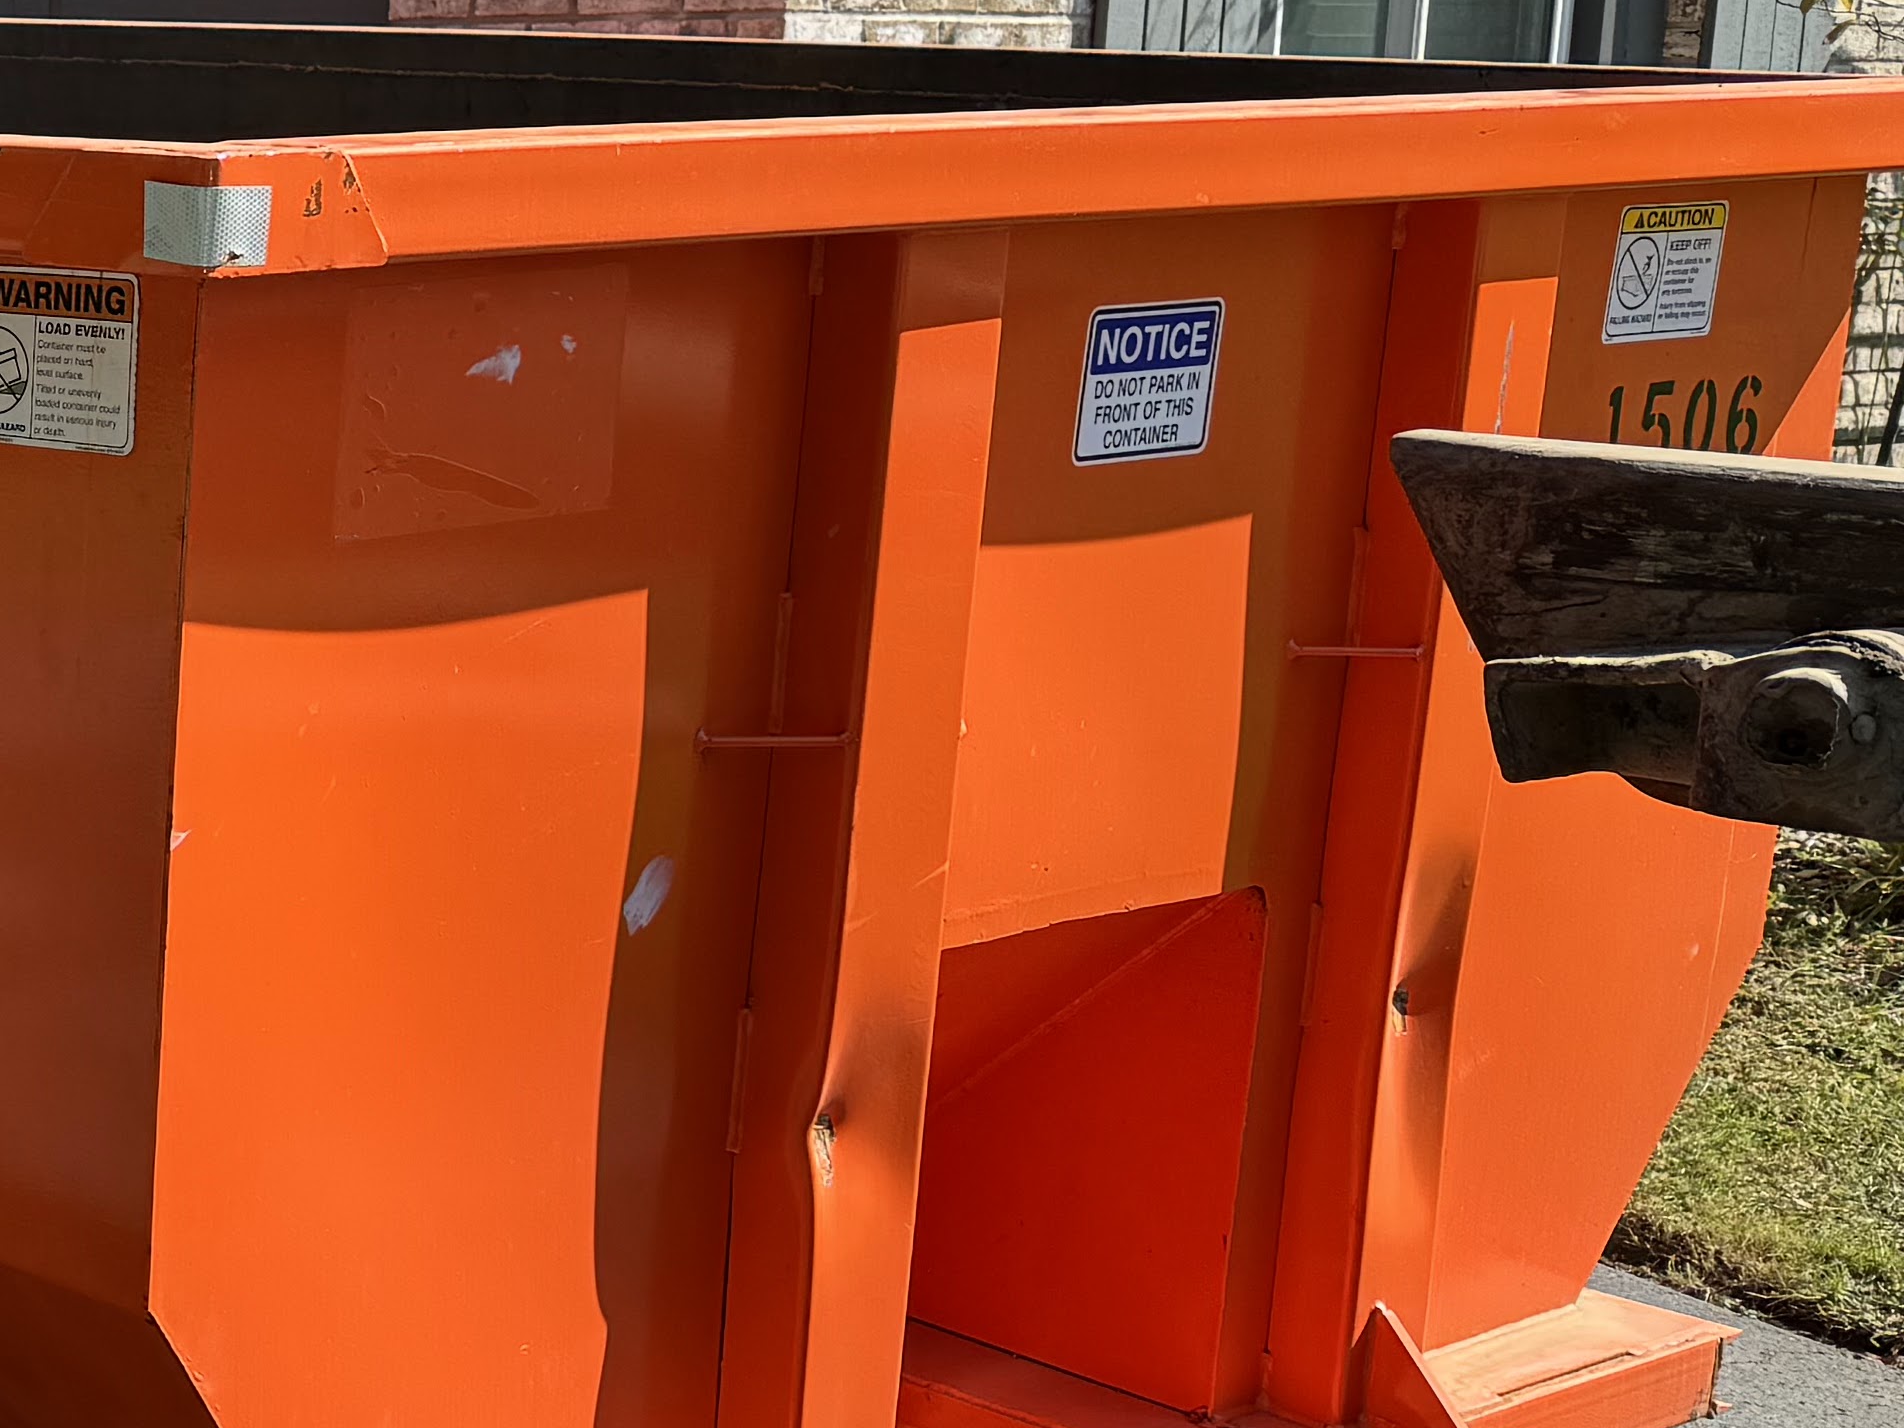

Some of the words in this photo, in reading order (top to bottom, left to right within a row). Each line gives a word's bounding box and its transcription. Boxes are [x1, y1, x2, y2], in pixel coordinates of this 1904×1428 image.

[1647, 208, 1714, 228] CAUTION
[38, 321, 71, 336] LOAD
[75, 325, 125, 340] EVENLY!
[1097, 321, 1210, 366] NOTICE
[1094, 380, 1114, 399] DO
[1117, 376, 1146, 398] NOT
[1148, 373, 1184, 394] PARK
[1187, 372, 1201, 390] IN
[1094, 402, 1140, 424] FRONT
[1143, 400, 1162, 420] OF
[1165, 397, 1194, 418] THIS
[1609, 375, 1763, 453] 1506
[1103, 424, 1179, 449] CONTAINER
